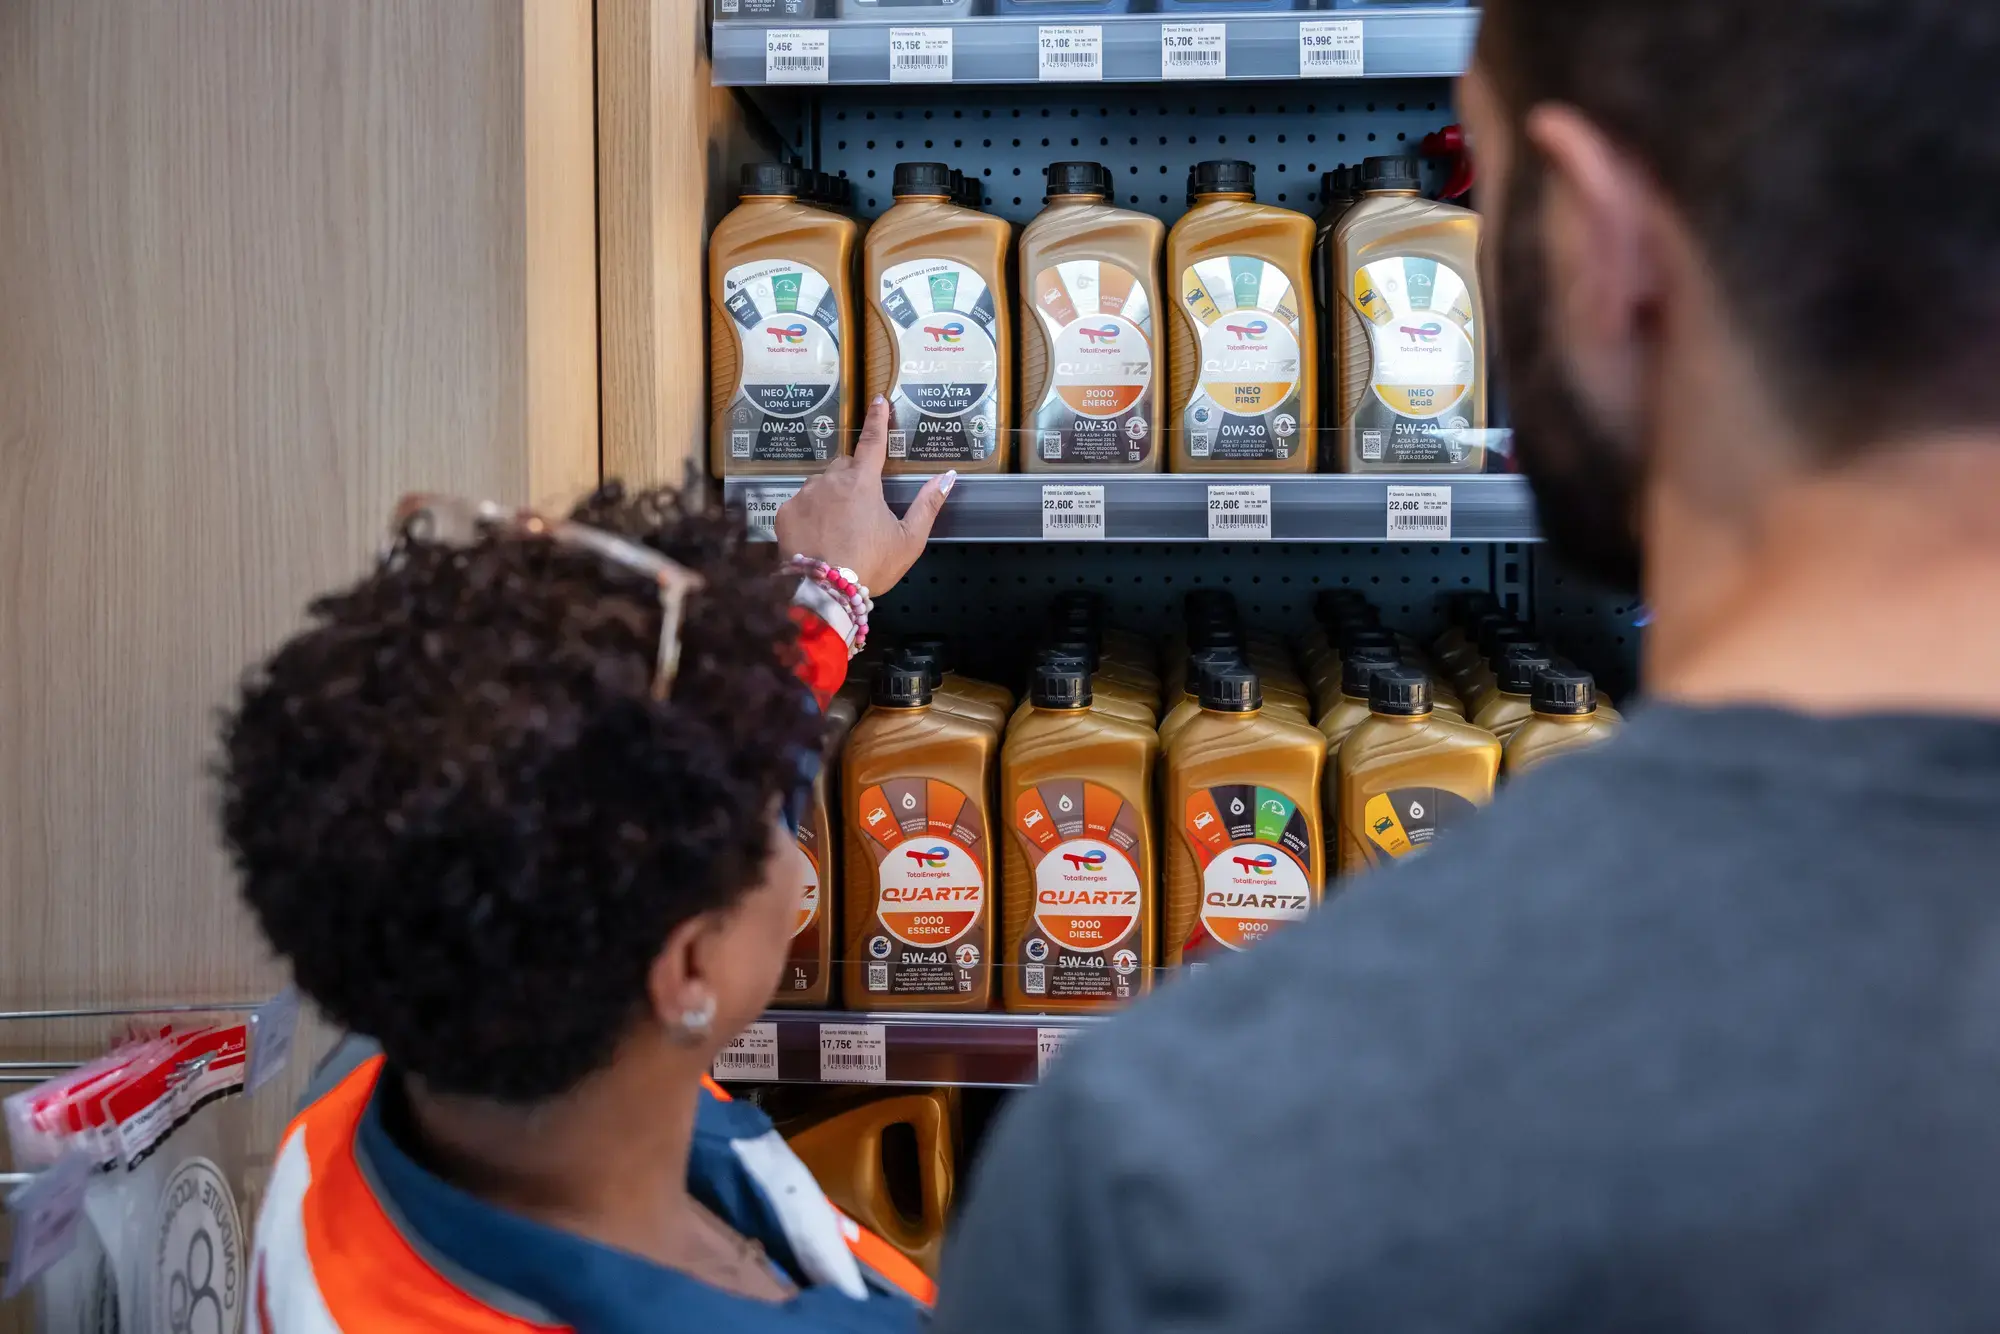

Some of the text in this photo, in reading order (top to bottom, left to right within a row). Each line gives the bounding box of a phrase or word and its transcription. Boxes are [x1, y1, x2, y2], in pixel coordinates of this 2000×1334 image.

[892, 41, 921, 50] 13,15€
[1041, 39, 1070, 48] 12,10€
[1164, 36, 1193, 46] 15,70€
[1303, 36, 1332, 46] 15,99€
[768, 42, 792, 51] 9,45€
[738, 266, 791, 285] COMPATIBLE HYBRIDE
[895, 270, 925, 284] COMPATIBLE
[818, 307, 836, 321] ESSENCE
[975, 306, 993, 320] ESSENCE
[1277, 309, 1292, 321] DIESEL
[1279, 304, 1296, 318] ESSENCE
[816, 312, 831, 324] DIESEL
[973, 311, 988, 323] DIESEL
[761, 389, 784, 397] INEO
[1086, 390, 1114, 398] 9000
[1235, 387, 1261, 395] INEO
[1408, 389, 1434, 397] INEO
[763, 422, 804, 433] 0W-20
[919, 422, 961, 433] 0W-20
[1074, 420, 1117, 431] 0W-30
[1222, 425, 1265, 436] 0W-30
[1395, 424, 1438, 435] 5W-20
[815, 439, 826, 448] 1L
[972, 438, 984, 447] 1L
[1128, 440, 1140, 450] 1L
[1276, 437, 1288, 446] 1L
[1451, 440, 1462, 449] 1L
[748, 502, 777, 511] 23,65€
[1044, 500, 1074, 509] 22,60€
[1210, 500, 1239, 509] 22,60€
[1389, 501, 1419, 510] 22,60€
[929, 821, 952, 829] ESSENCE
[1088, 824, 1106, 832] DIESEL
[1283, 838, 1300, 851] DIESEL
[1284, 832, 1307, 849] GASOLINE
[881, 887, 979, 903] QUARTZ
[1038, 890, 1137, 906] QUARTZ
[1206, 892, 1307, 909] QUARTZ
[914, 916, 944, 925] 9000
[1071, 920, 1101, 929] 9000
[908, 926, 950, 935] ESSENCE
[1238, 922, 1268, 932] 9000
[902, 952, 947, 964] 5W-40
[1059, 956, 1104, 968] 5W-40
[795, 967, 806, 977] 1L
[959, 969, 971, 979] 1L
[1117, 975, 1129, 985] 1L
[821, 1040, 852, 1049] 17,75€
